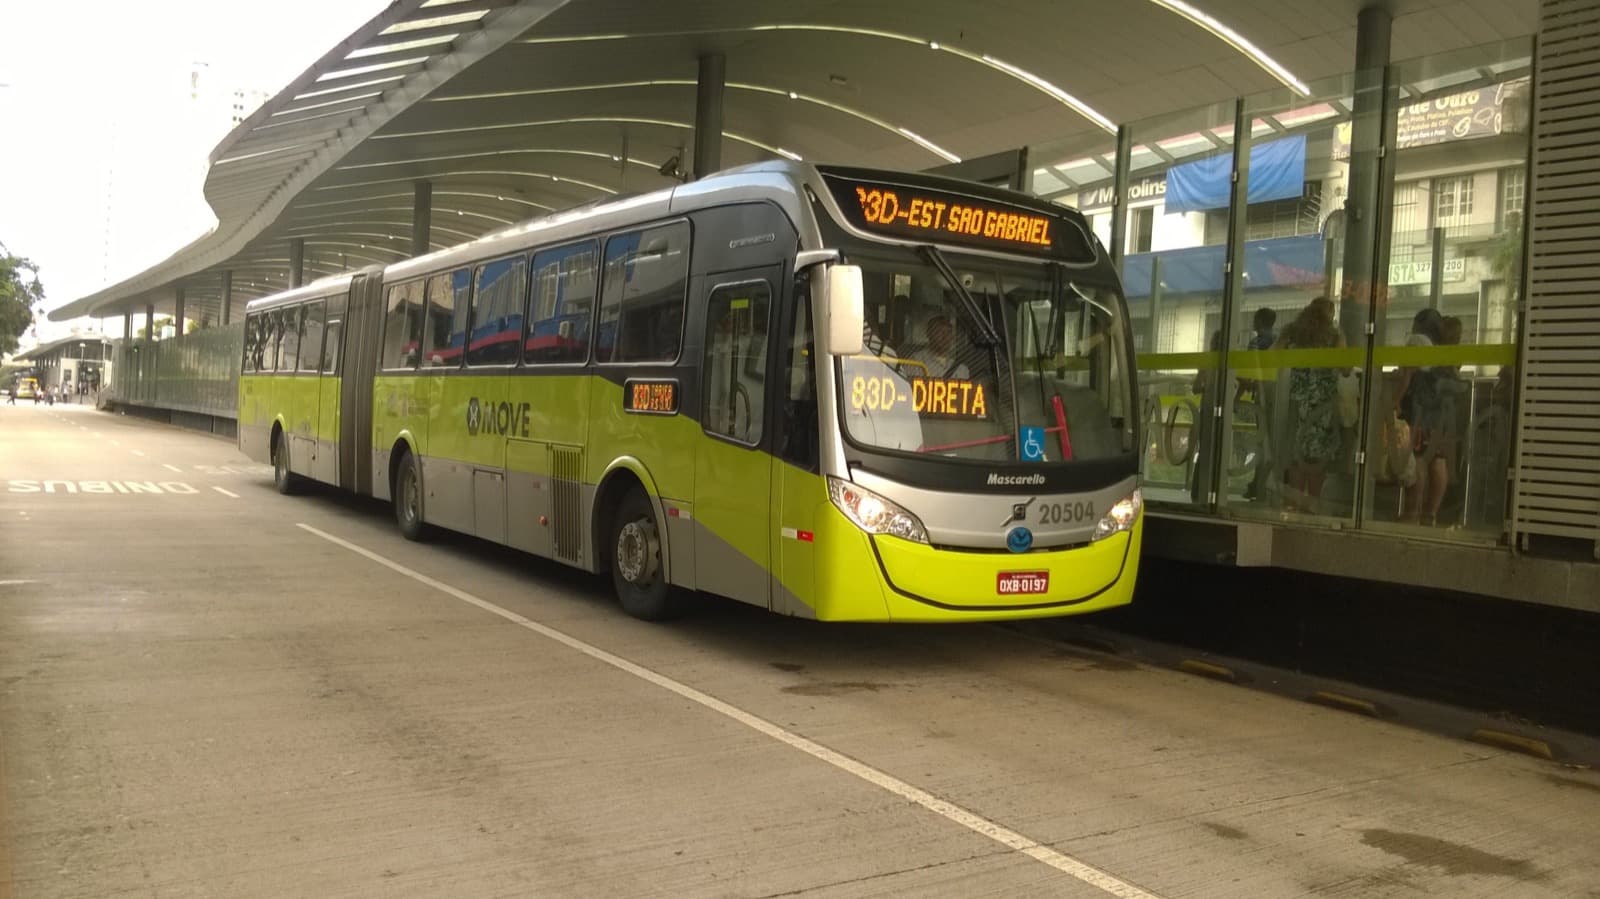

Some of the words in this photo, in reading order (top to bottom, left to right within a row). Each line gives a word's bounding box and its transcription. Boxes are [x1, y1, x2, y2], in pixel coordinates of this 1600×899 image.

[1098, 179, 1167, 204] Mrolins
[984, 212, 1051, 245] GABRIEL
[912, 379, 986, 416] DIRETA
[481, 401, 530, 437] MOVE
[987, 473, 1046, 486] Mascarello
[1038, 501, 1095, 525] 20504
